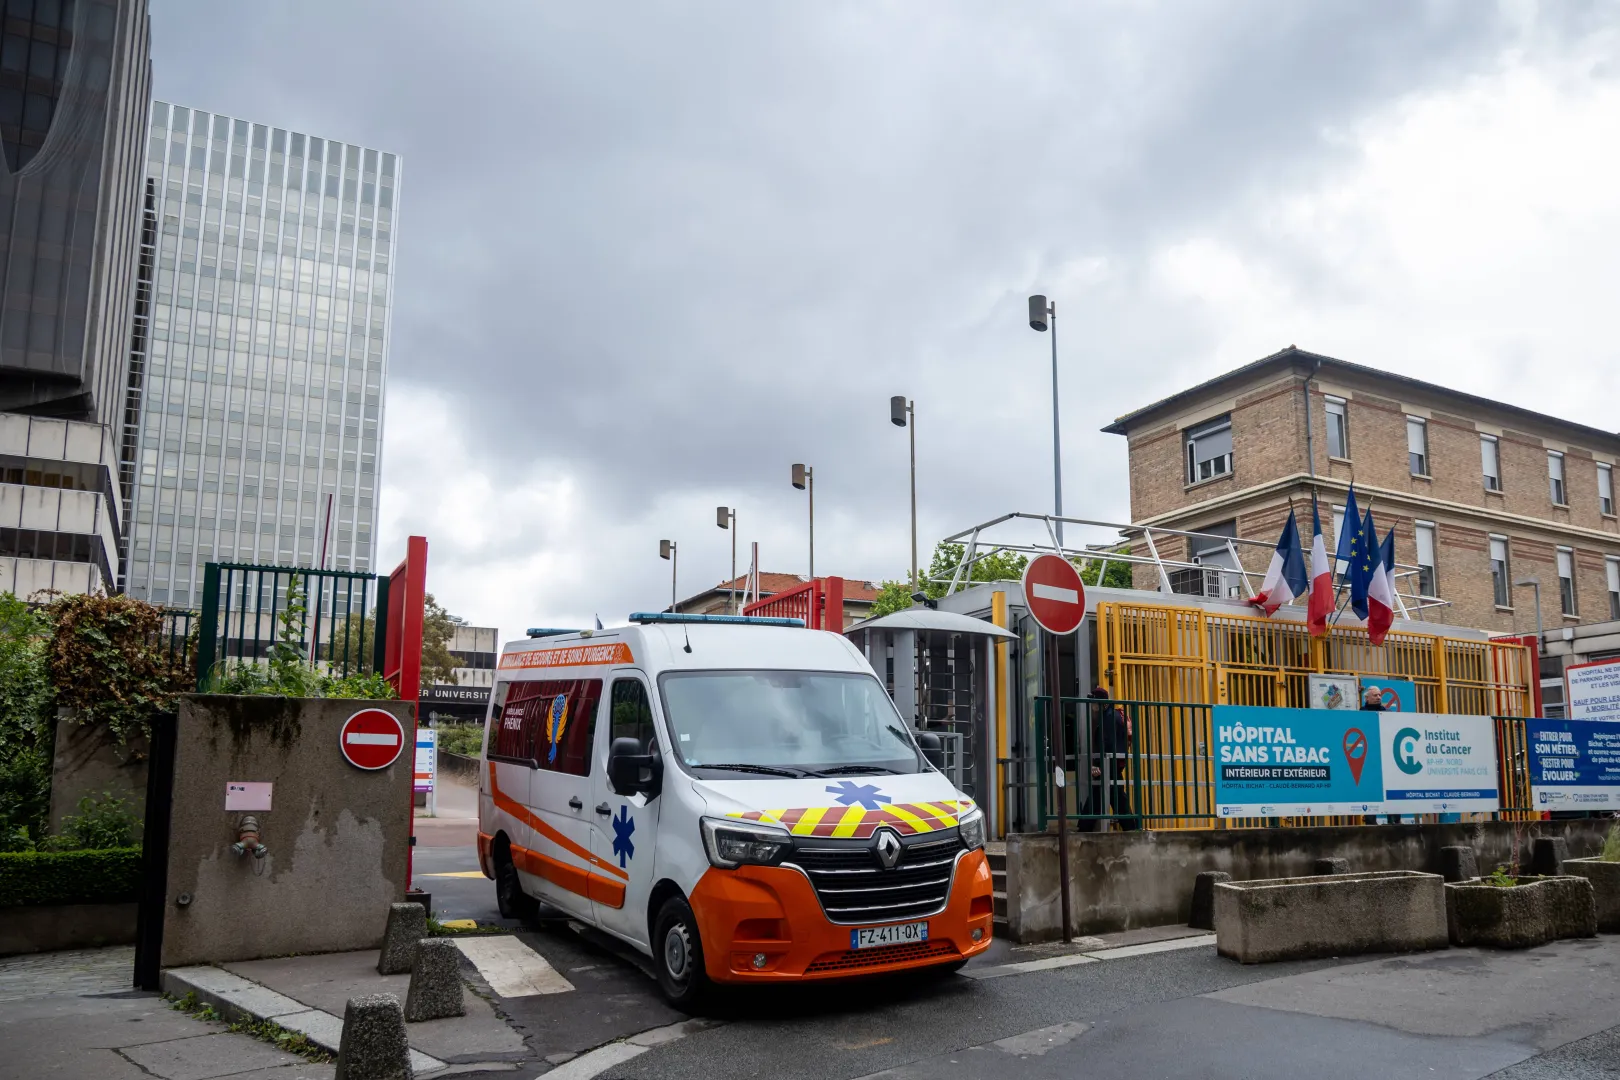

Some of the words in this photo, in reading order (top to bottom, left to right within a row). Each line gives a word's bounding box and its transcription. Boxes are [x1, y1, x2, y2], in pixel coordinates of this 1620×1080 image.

[552, 649, 560, 665] ET
[560, 649, 567, 664] DE
[567, 647, 583, 664] SOINS
[582, 645, 616, 663] D'URGENCE
[1591, 697, 1607, 705] POUR
[504, 716, 522, 731] PHÉNIX
[1219, 721, 1296, 744] HÔPITAL
[1424, 729, 1460, 741] Institut
[1540, 731, 1558, 742] ENTRER
[1559, 732, 1573, 742] POUR
[1220, 745, 1269, 762] SANS
[1272, 746, 1330, 763] TABAC
[1426, 742, 1438, 755] du
[1440, 744, 1472, 755] Cancer
[1535, 743, 1550, 754] SON
[1542, 758, 1560, 769] RESTER
[1560, 758, 1575, 769] POUR
[1225, 766, 1270, 778] INTÉRIEUR
[1272, 768, 1282, 778] ET
[1284, 767, 1327, 778] EXTÉRIEUR
[1542, 769, 1577, 781] ÉVOLUER.
[859, 923, 919, 945] FZ-411-QX
